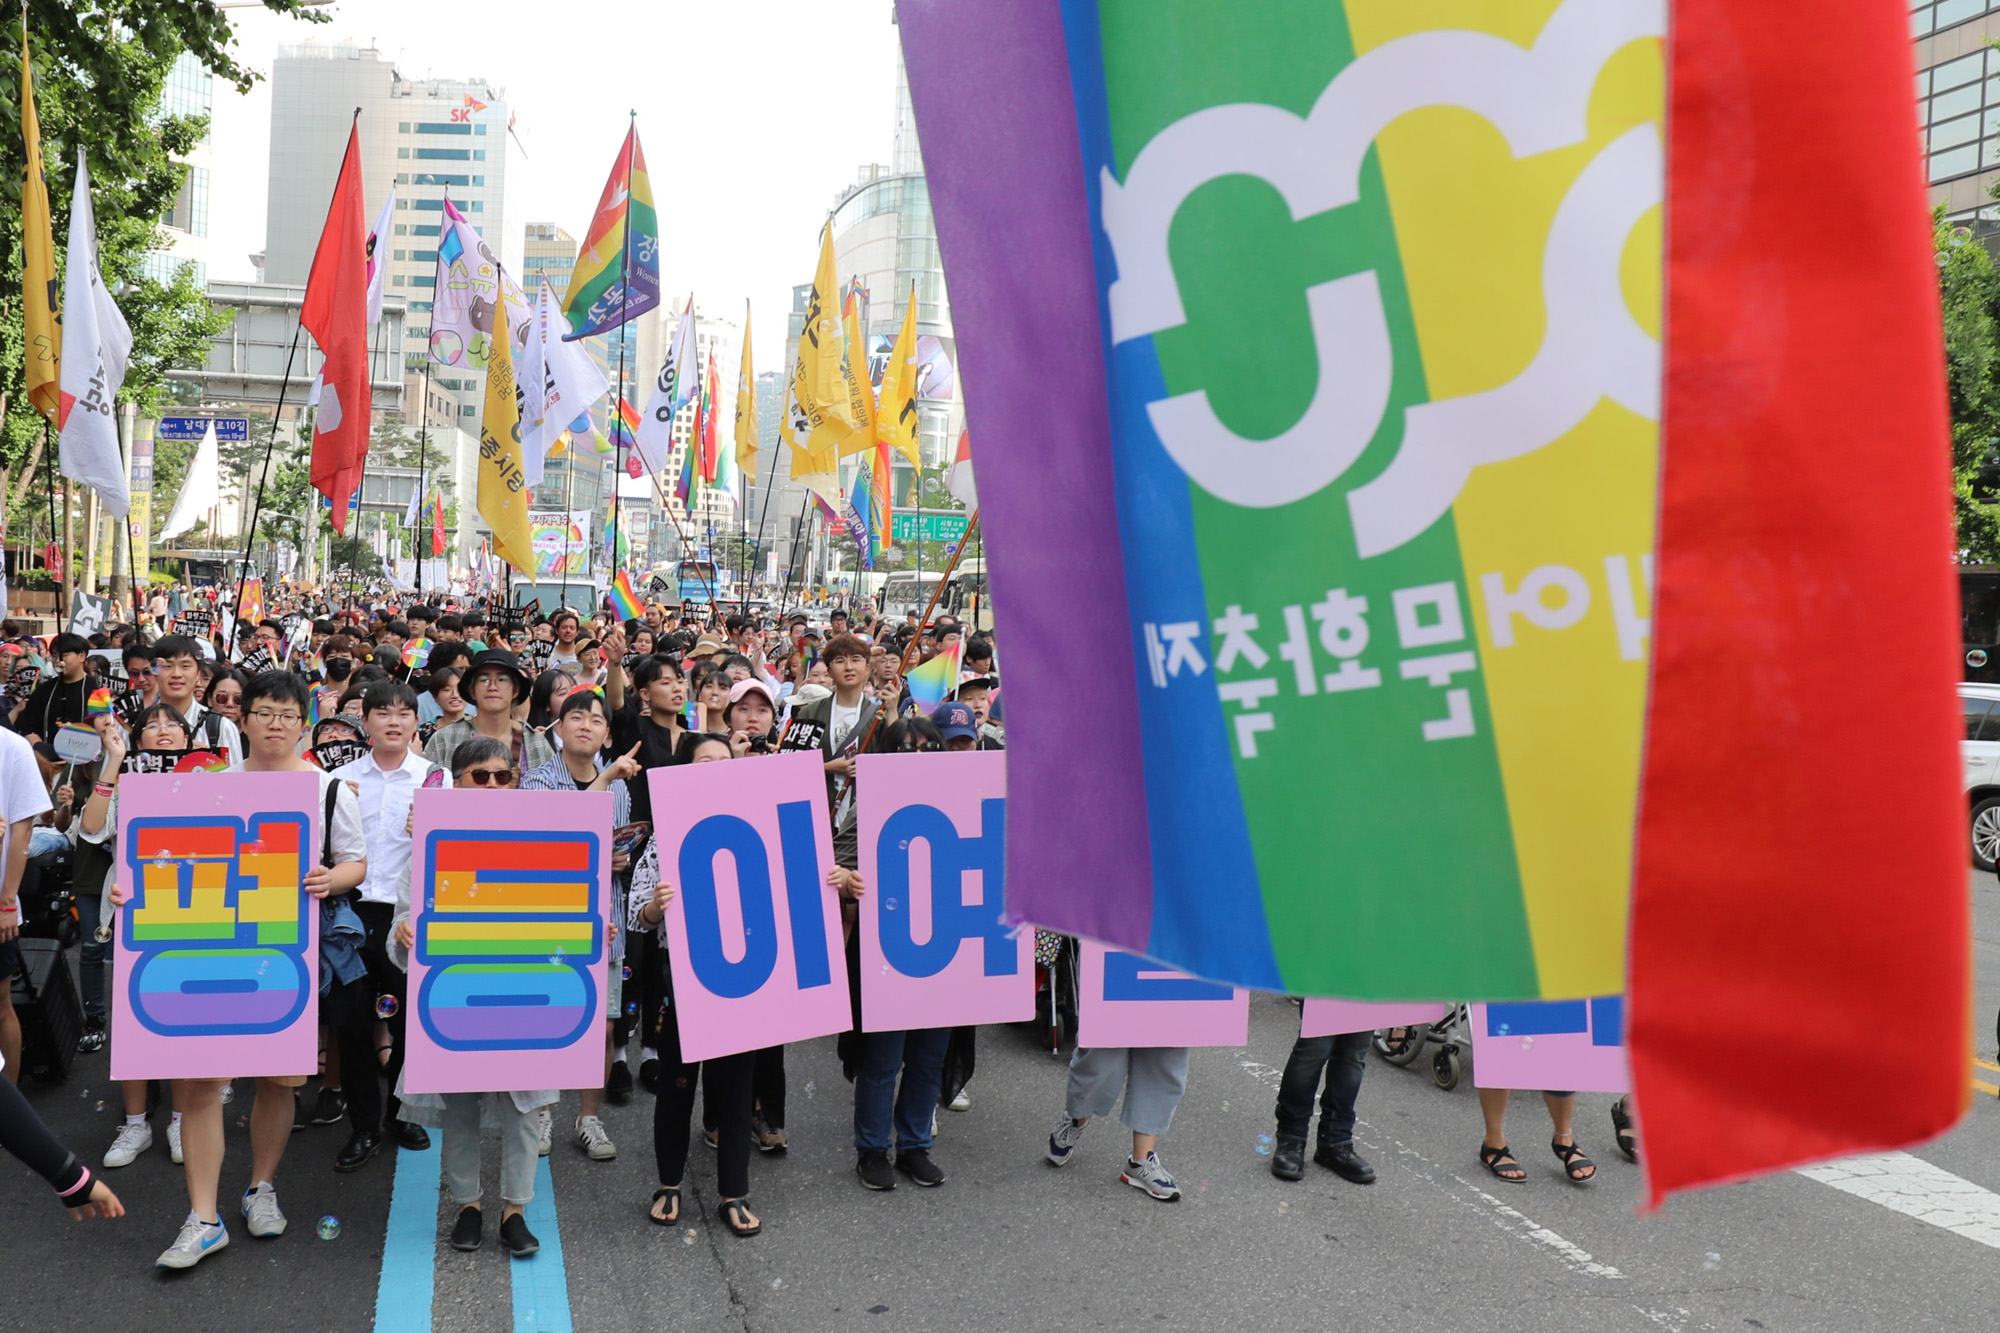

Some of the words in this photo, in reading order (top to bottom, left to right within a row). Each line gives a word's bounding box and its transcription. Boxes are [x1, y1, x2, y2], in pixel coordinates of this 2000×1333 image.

[450, 108, 471, 122] SK
[184, 419, 246, 432] 남대로10길
[122, 811, 311, 1037] 평
[416, 829, 604, 1052] 등
[678, 799, 832, 999] 이
[876, 797, 1018, 979] 여
